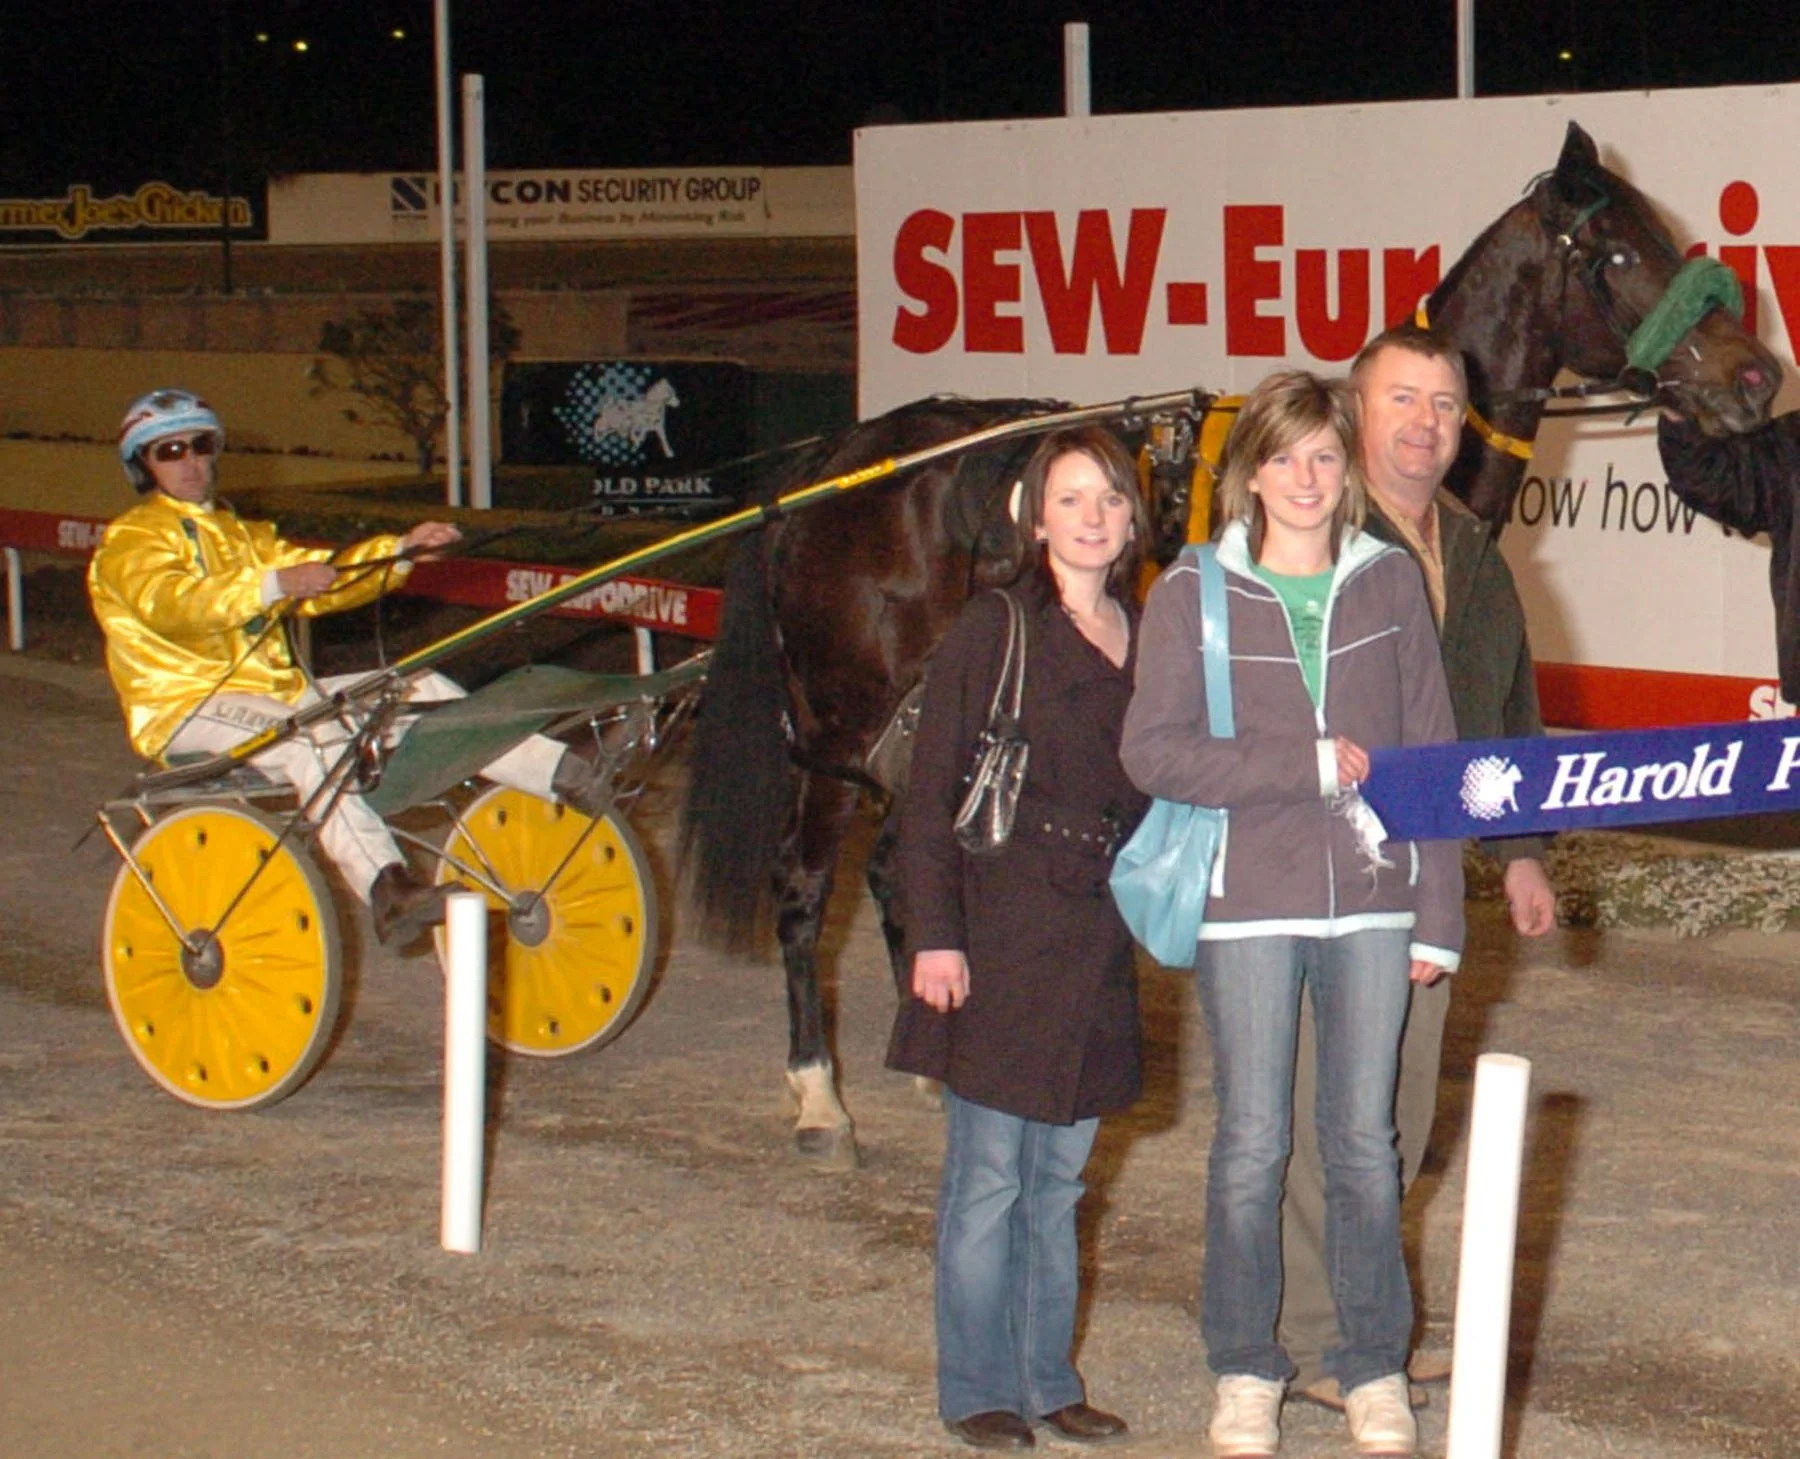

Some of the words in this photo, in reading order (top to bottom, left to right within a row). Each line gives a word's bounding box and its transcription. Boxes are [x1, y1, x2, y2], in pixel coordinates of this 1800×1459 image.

[577, 178, 681, 203] SECURITY
[685, 176, 761, 201] GROUP
[645, 476, 713, 495] PARK
[1540, 740, 1744, 810] Harold
